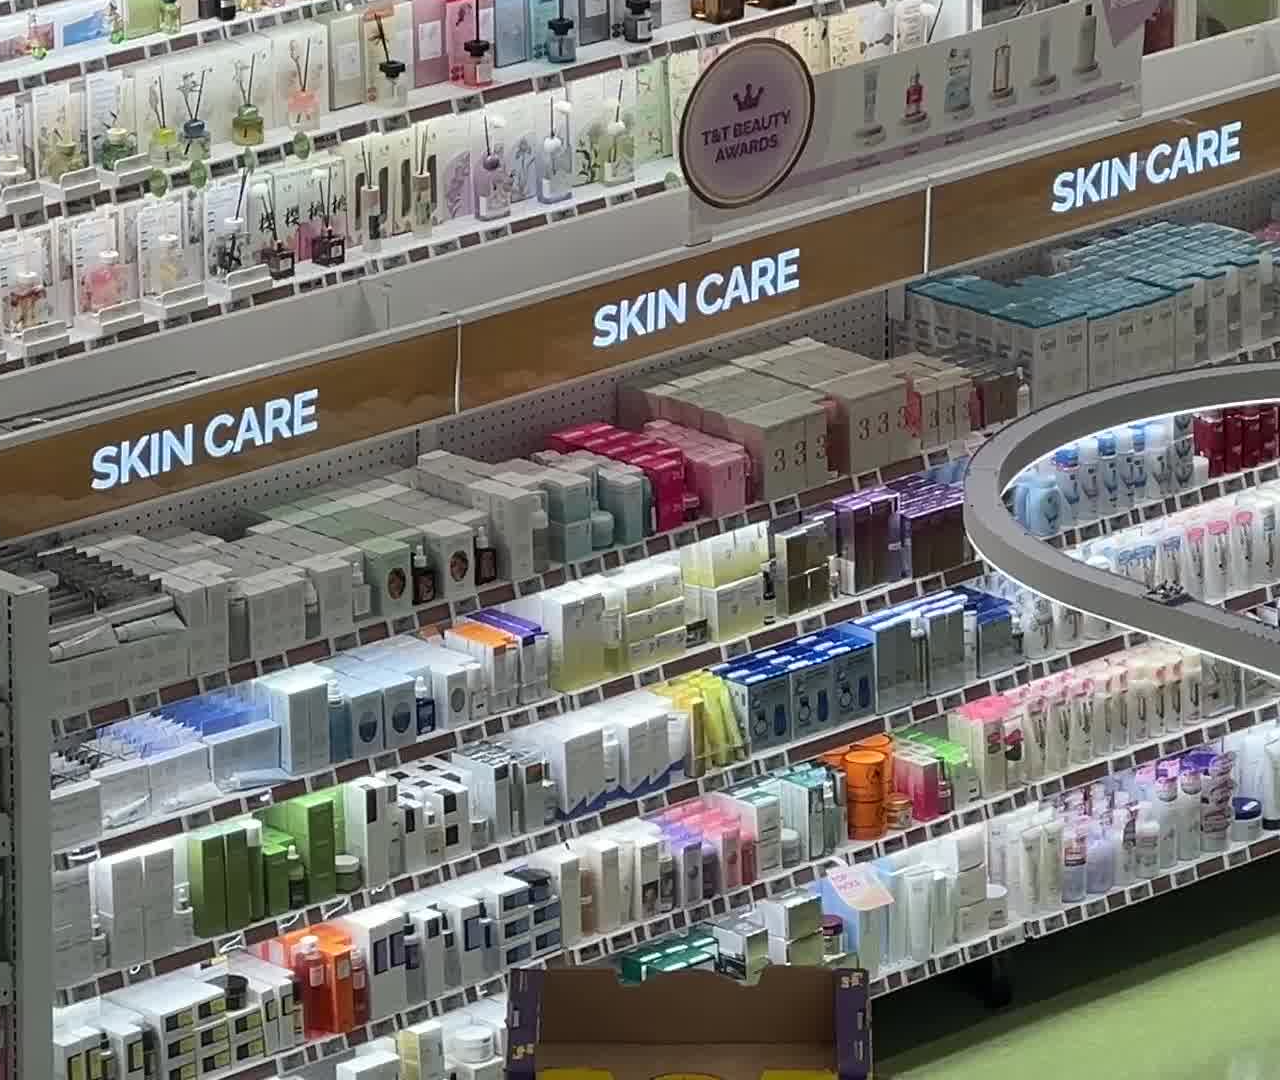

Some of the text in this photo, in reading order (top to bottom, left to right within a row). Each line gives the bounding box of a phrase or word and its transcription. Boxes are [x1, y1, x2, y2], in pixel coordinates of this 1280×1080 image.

[732, 108, 792, 140] BEAUTY
[714, 133, 778, 164] AWARDS
[1053, 120, 1242, 213] SKIN CARE
[592, 247, 801, 349] SKIN CARE
[858, 416, 871, 441] 3
[877, 411, 890, 434] 3
[91, 388, 319, 490] SKIN CARE
[794, 440, 807, 467] 3
[773, 447, 787, 473] 3
